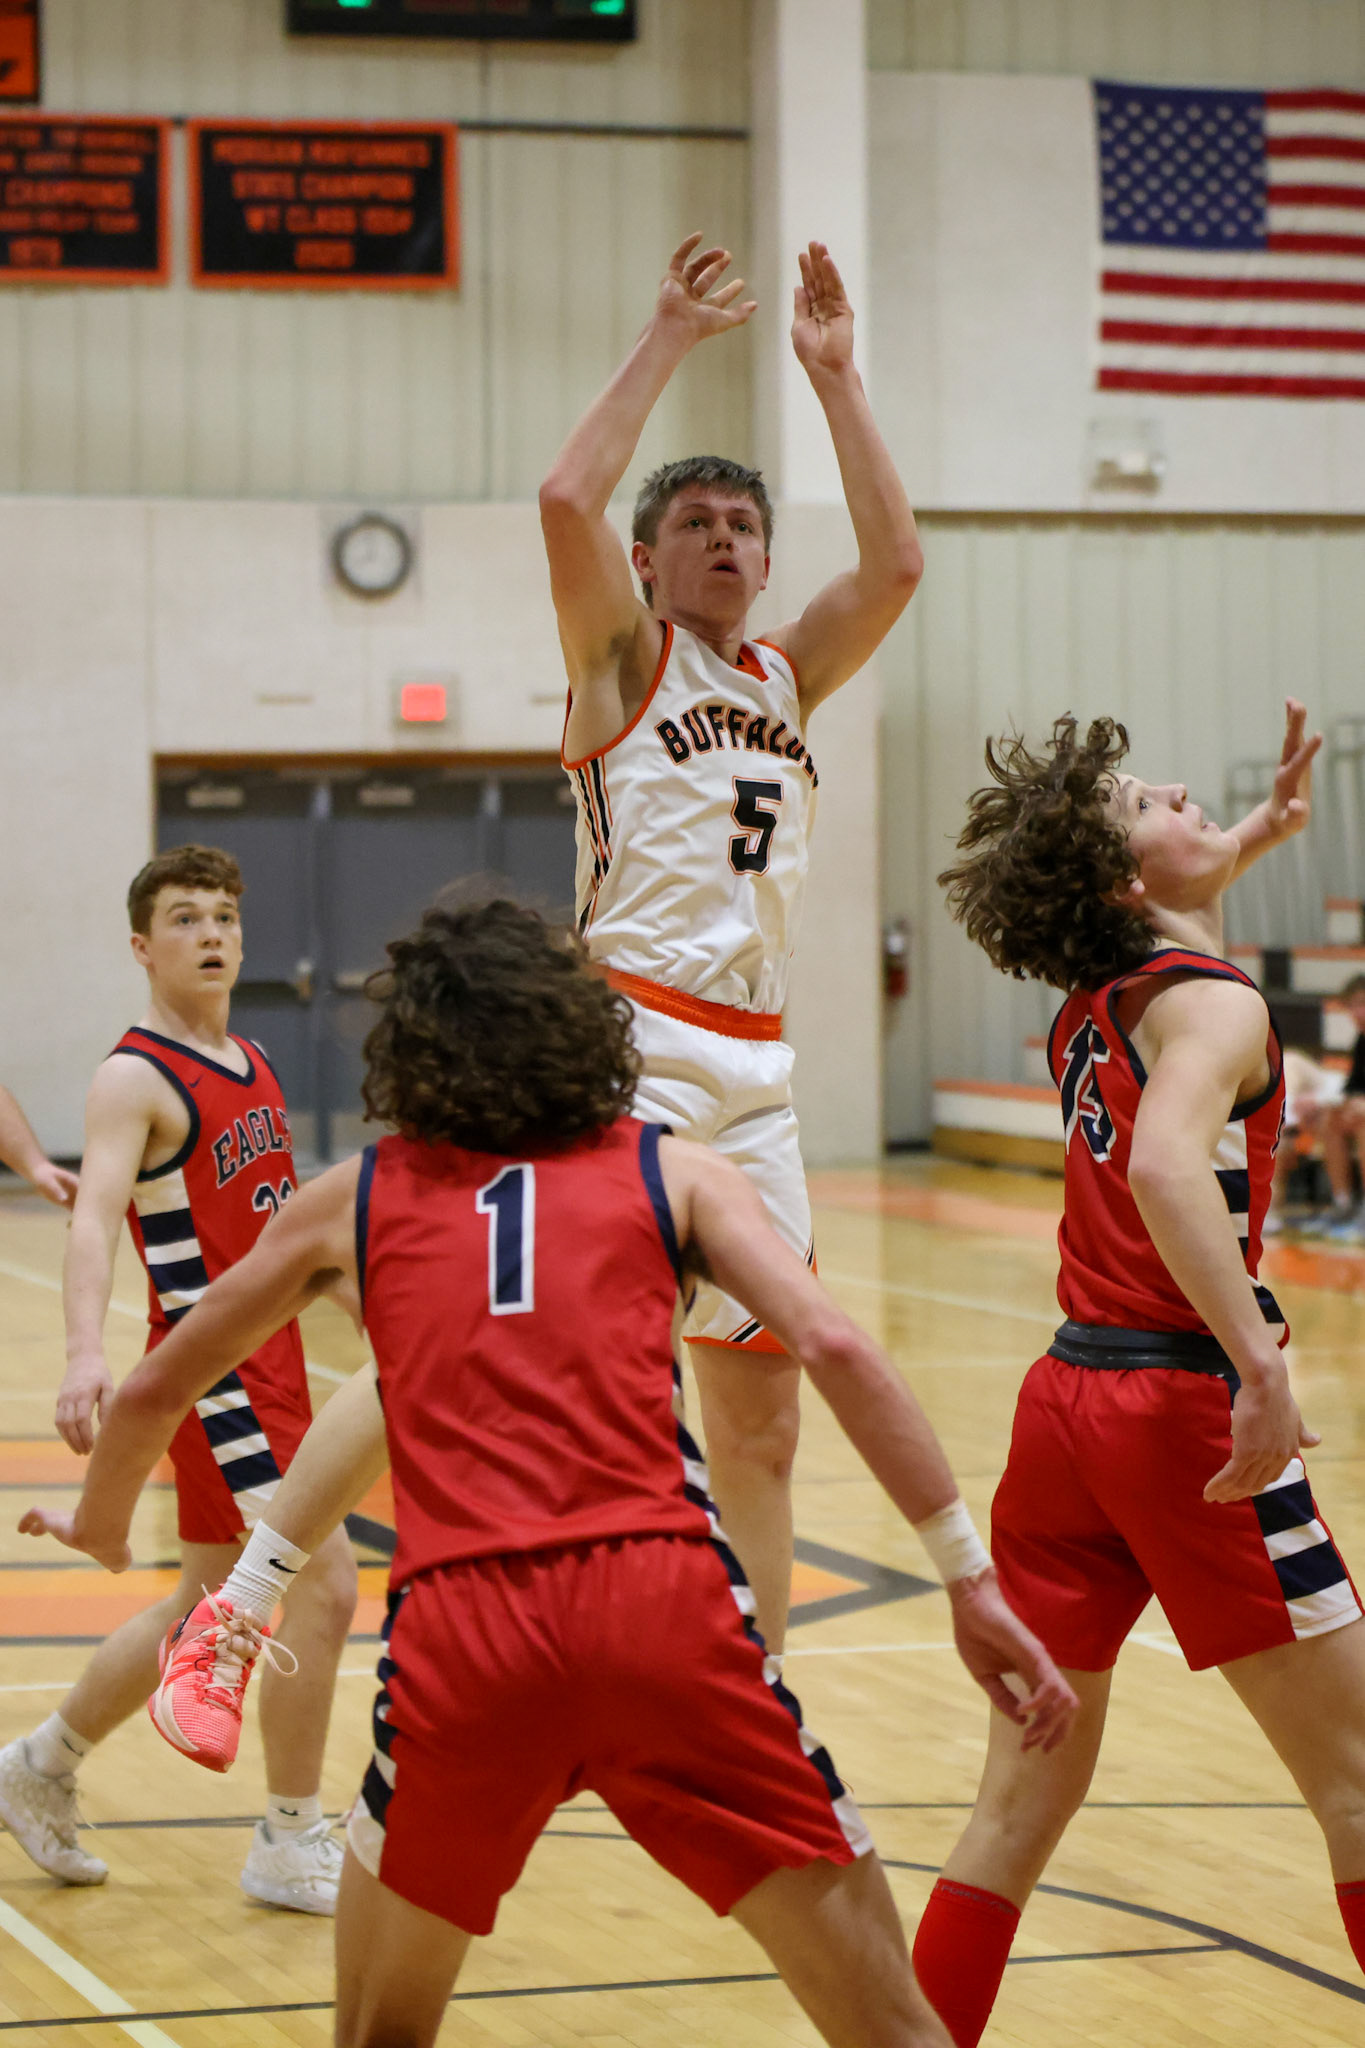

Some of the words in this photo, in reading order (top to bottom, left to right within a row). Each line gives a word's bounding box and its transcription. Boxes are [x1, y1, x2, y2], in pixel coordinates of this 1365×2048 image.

[654, 704, 819, 790] BUFFALO
[728, 776, 784, 877] 5
[1060, 1014, 1117, 1163] 15
[475, 1162, 536, 1316] 1
